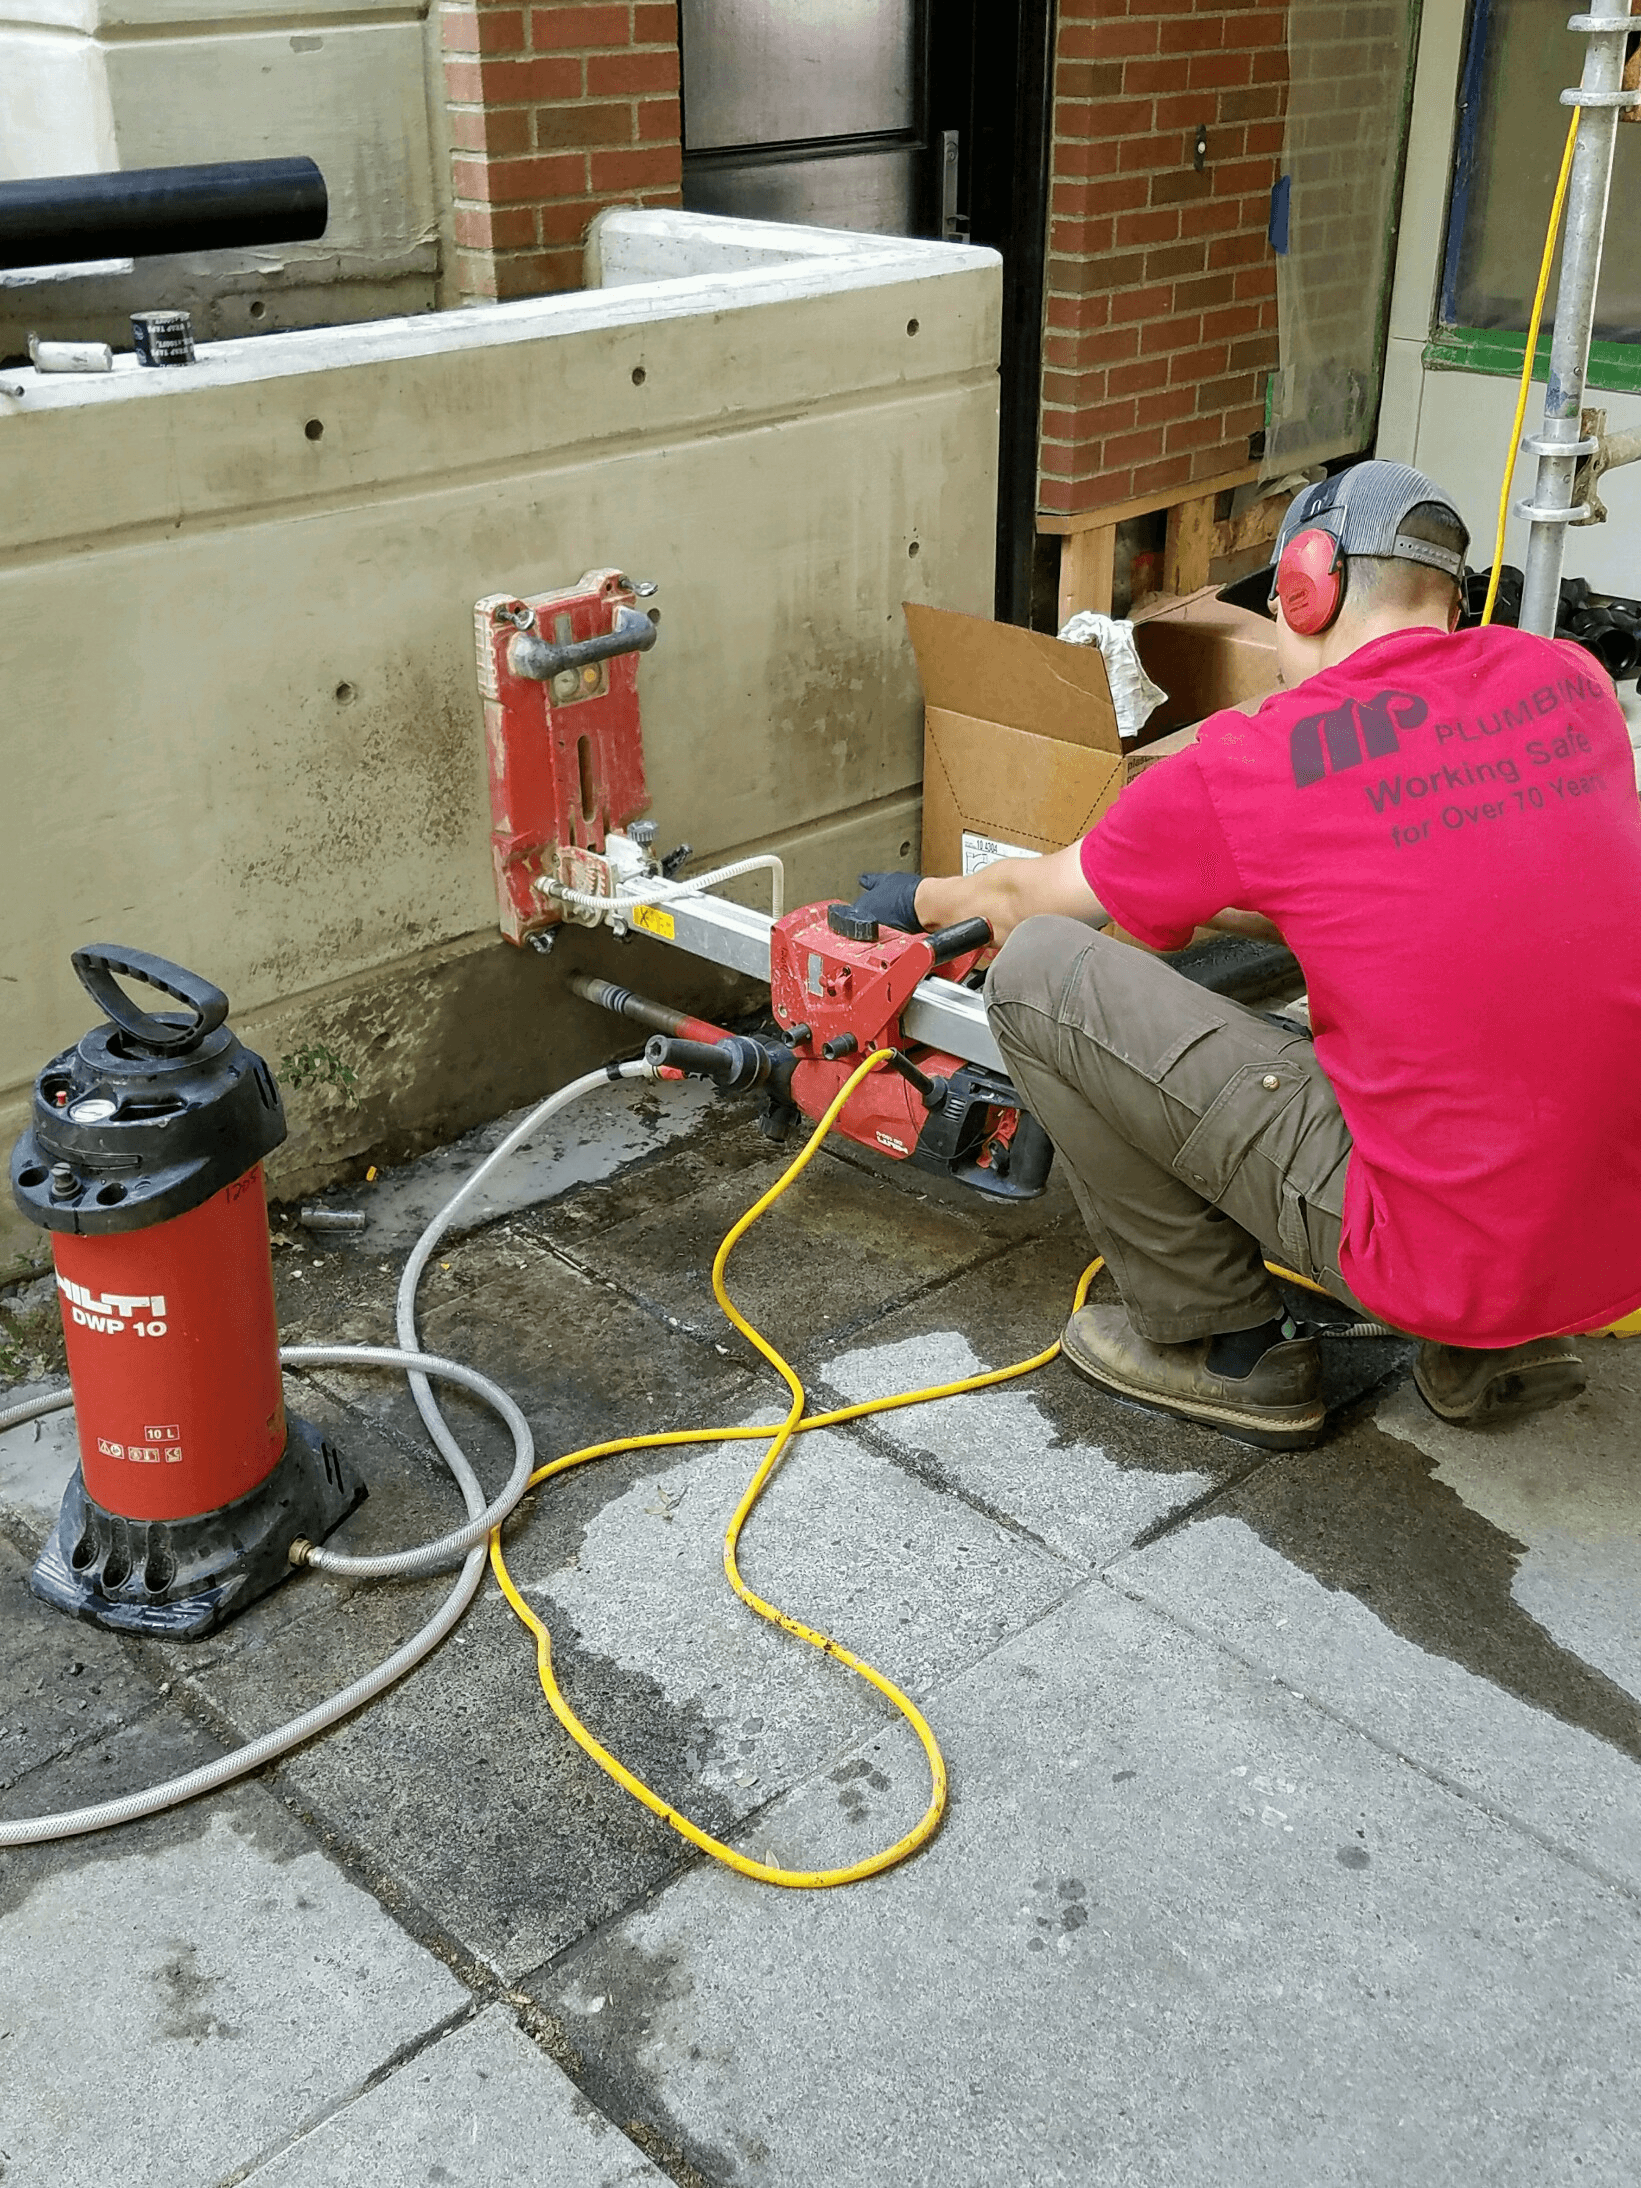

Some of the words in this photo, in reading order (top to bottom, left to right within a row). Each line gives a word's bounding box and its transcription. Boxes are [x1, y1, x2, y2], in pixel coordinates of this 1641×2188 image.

[1434, 674, 1603, 746] PLUMBING
[1363, 755, 1521, 814] Working
[1525, 724, 1592, 767] Safe
[1390, 820, 1432, 849] for
[1440, 800, 1505, 830] Over
[1511, 786, 1545, 812] 70
[56, 1269, 166, 1317] HILTI
[72, 1306, 125, 1335] DWP
[133, 1321, 168, 1337] 10
[147, 1429, 162, 1439] 10
[167, 1428, 175, 1439] L
